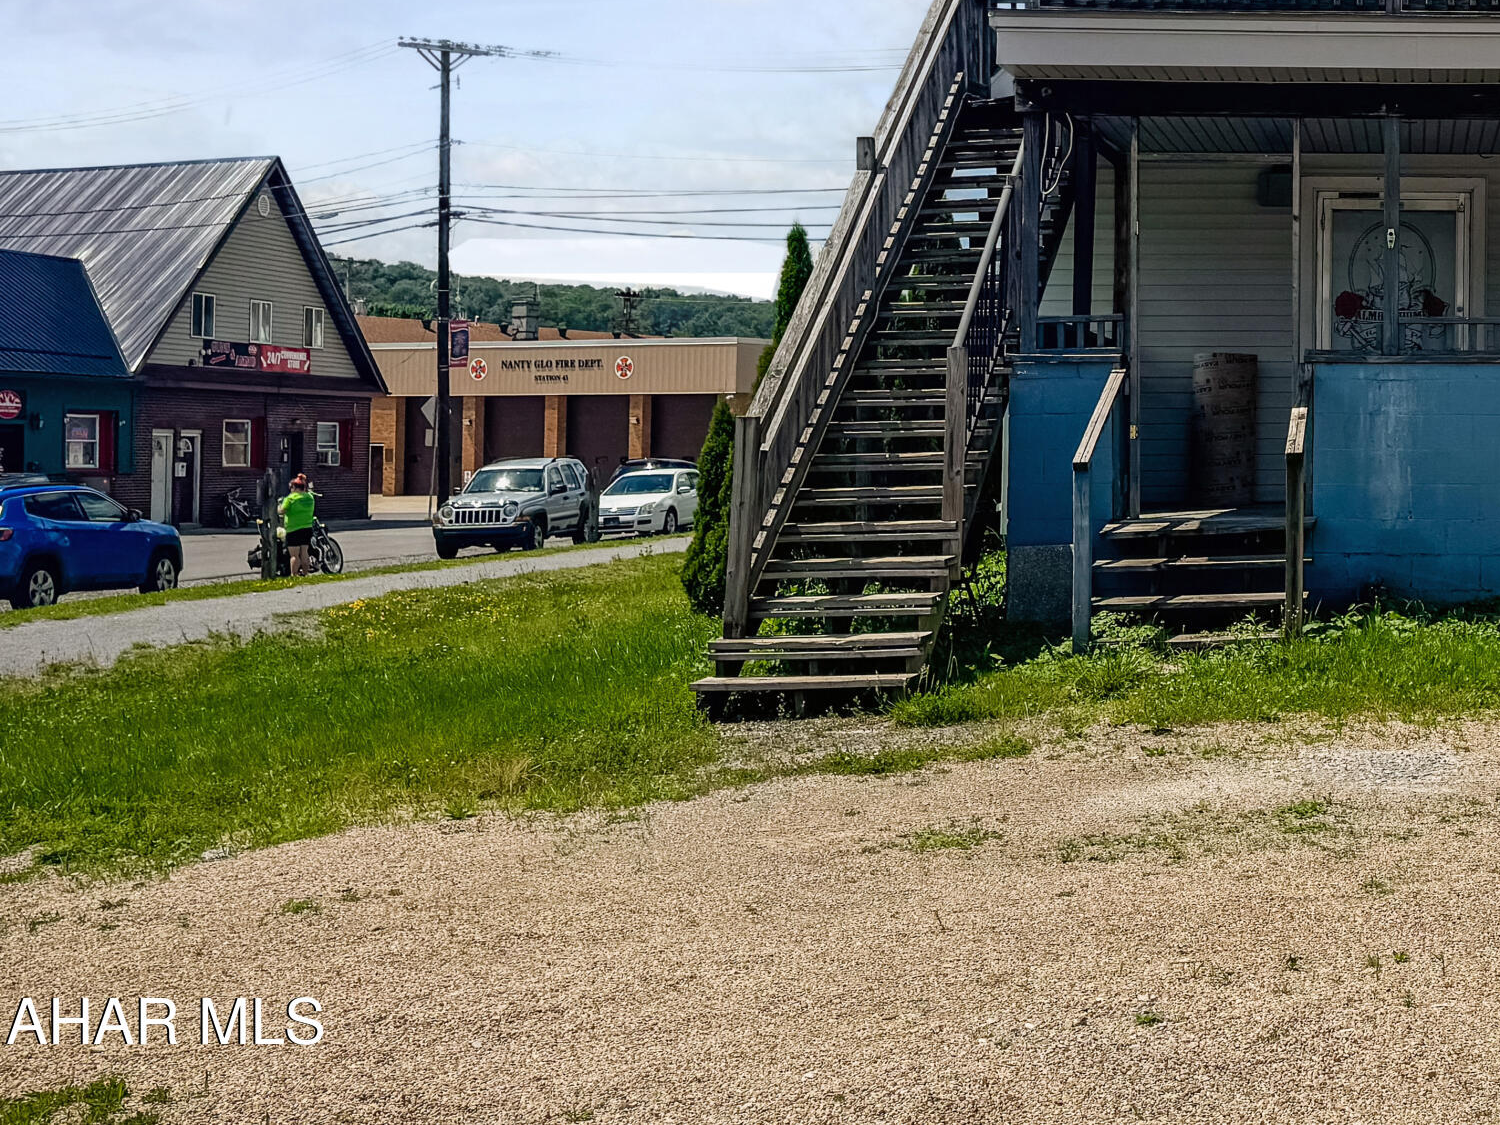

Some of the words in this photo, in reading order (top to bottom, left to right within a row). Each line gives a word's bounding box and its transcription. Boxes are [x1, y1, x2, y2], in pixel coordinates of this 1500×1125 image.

[267, 351, 281, 365] 24/7
[501, 360, 532, 369] NANTY
[534, 359, 552, 369] GLO
[555, 359, 576, 368] FIRE
[578, 359, 603, 368] DEPT.
